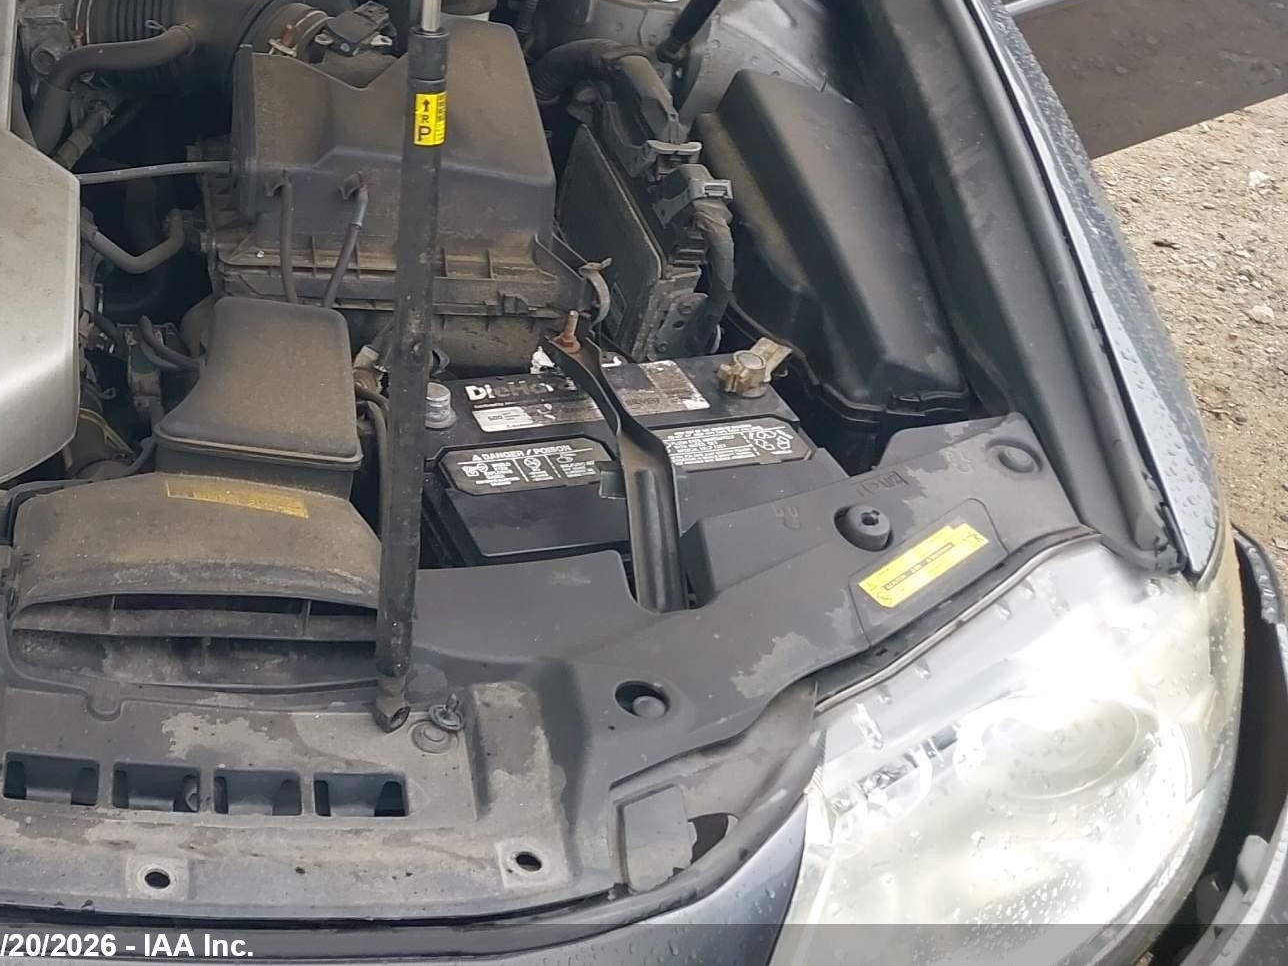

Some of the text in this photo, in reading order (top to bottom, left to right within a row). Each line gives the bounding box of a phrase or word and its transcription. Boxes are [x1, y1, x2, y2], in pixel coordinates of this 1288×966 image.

[417, 125, 431, 141] P
[481, 449, 525, 462] DANGER
[533, 444, 573, 455] POISON
